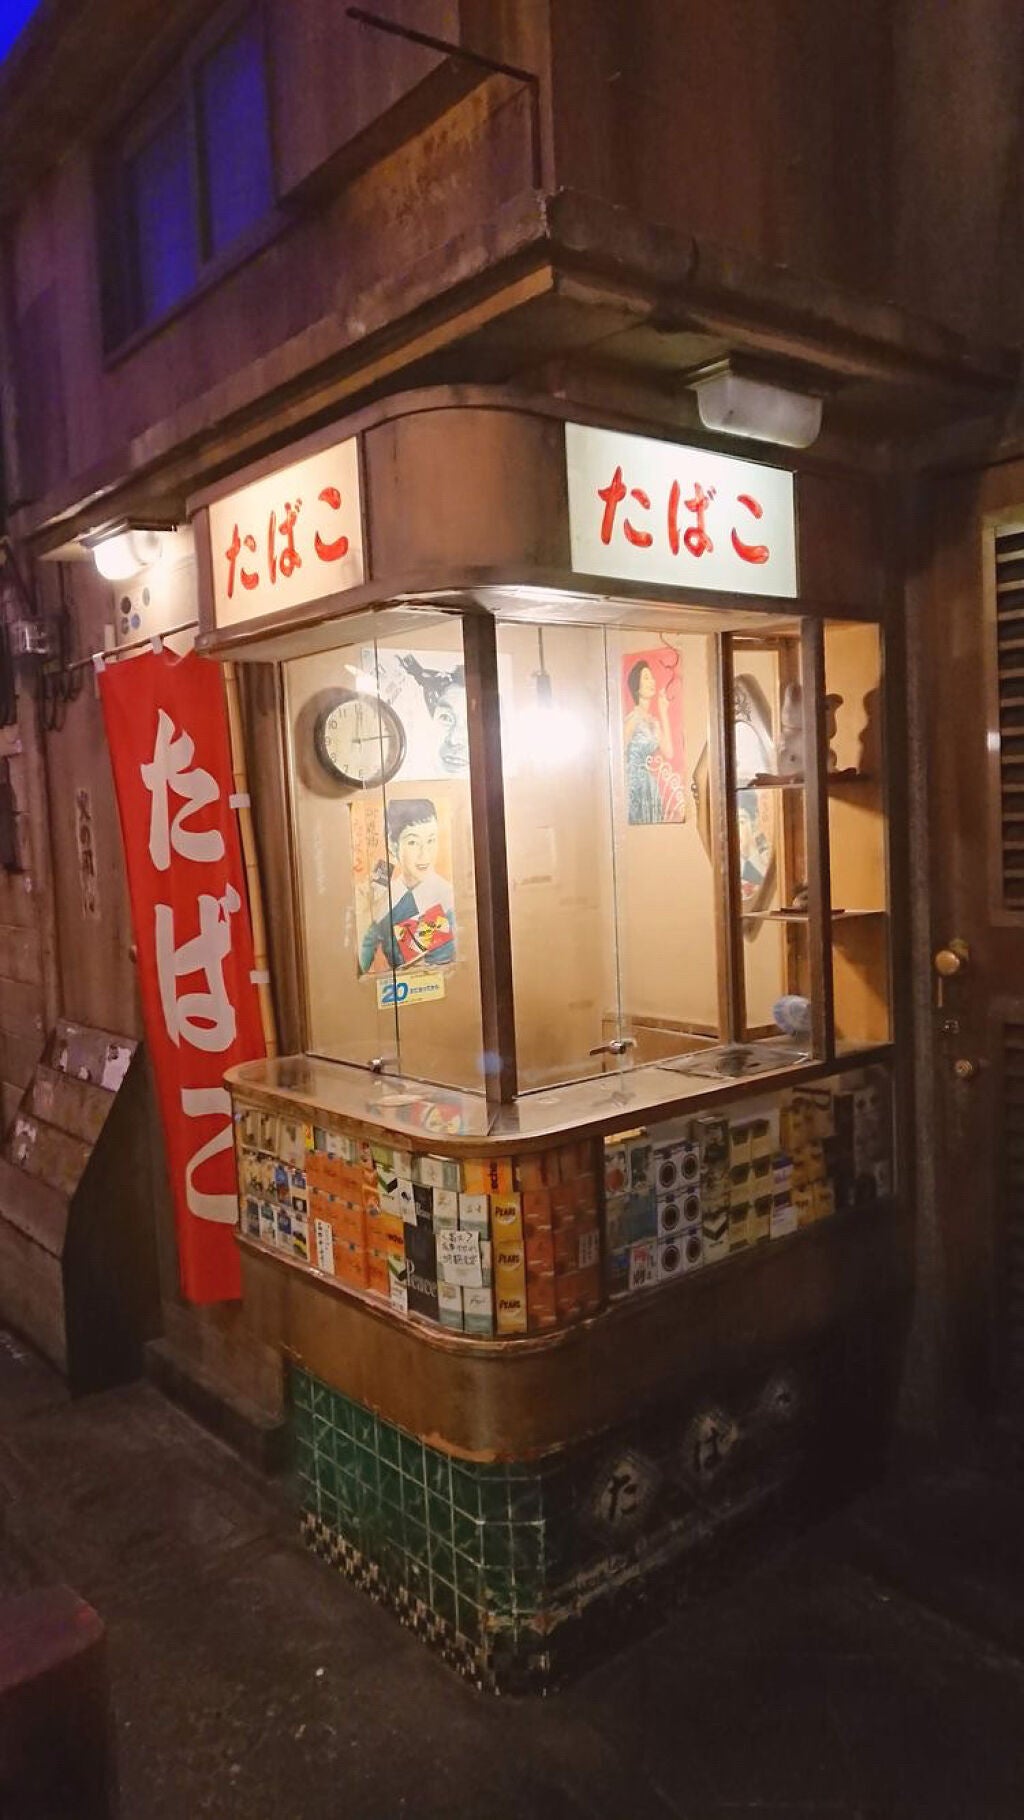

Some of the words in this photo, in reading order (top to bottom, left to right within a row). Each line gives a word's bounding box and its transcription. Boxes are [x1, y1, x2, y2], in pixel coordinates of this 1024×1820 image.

[225, 486, 349, 599] たばこ
[598, 465, 770, 564] たばこ
[140, 707, 241, 1225] たばこ
[381, 982, 409, 1004] 20
